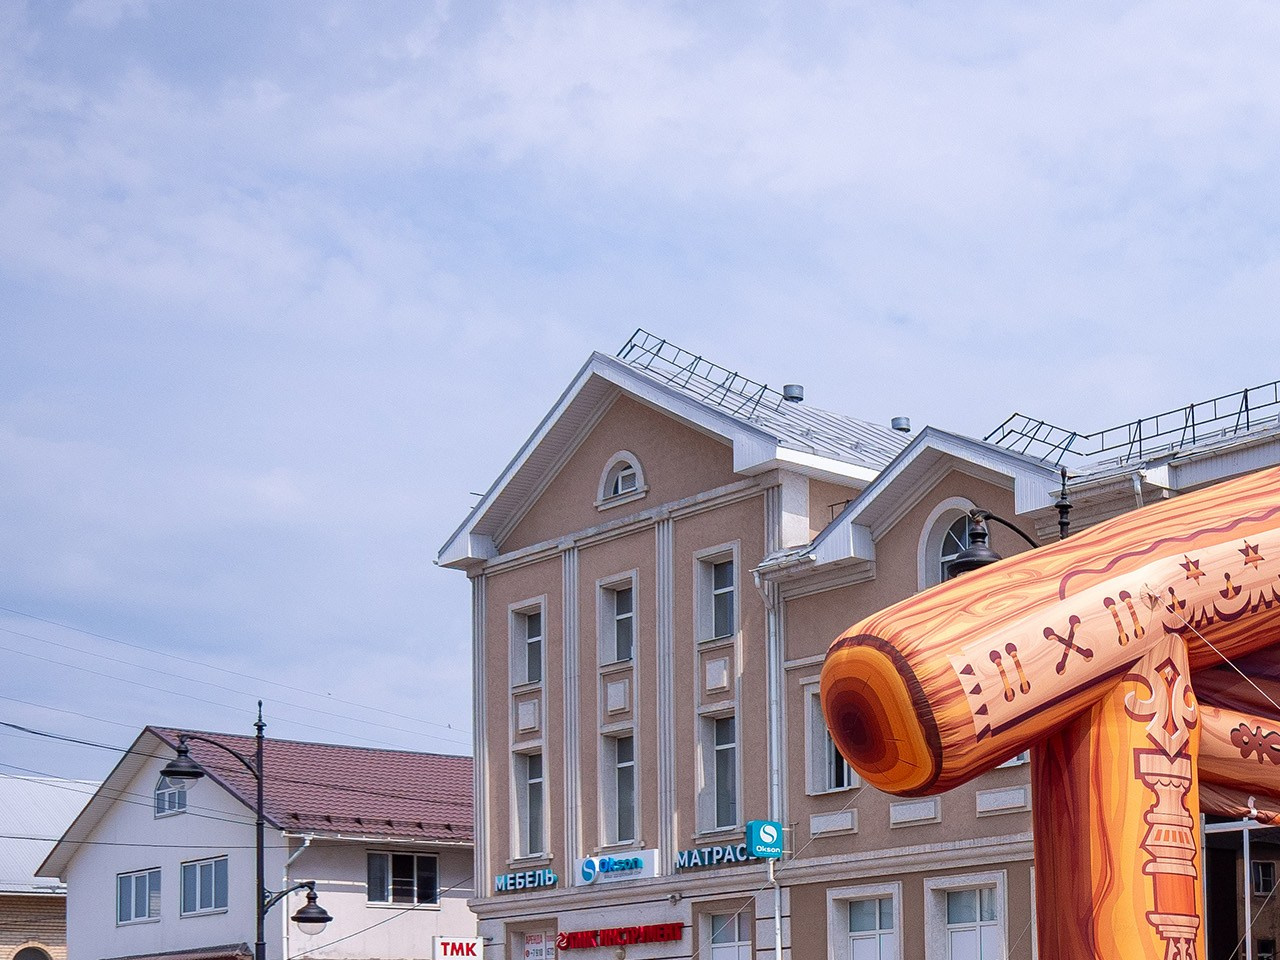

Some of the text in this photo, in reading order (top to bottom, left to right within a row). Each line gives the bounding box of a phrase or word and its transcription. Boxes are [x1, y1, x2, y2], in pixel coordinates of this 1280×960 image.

[676, 842, 757, 869] МАТРАС
[495, 869, 557, 892] МЕБЕЛЬ
[440, 942, 477, 956] ТМК
